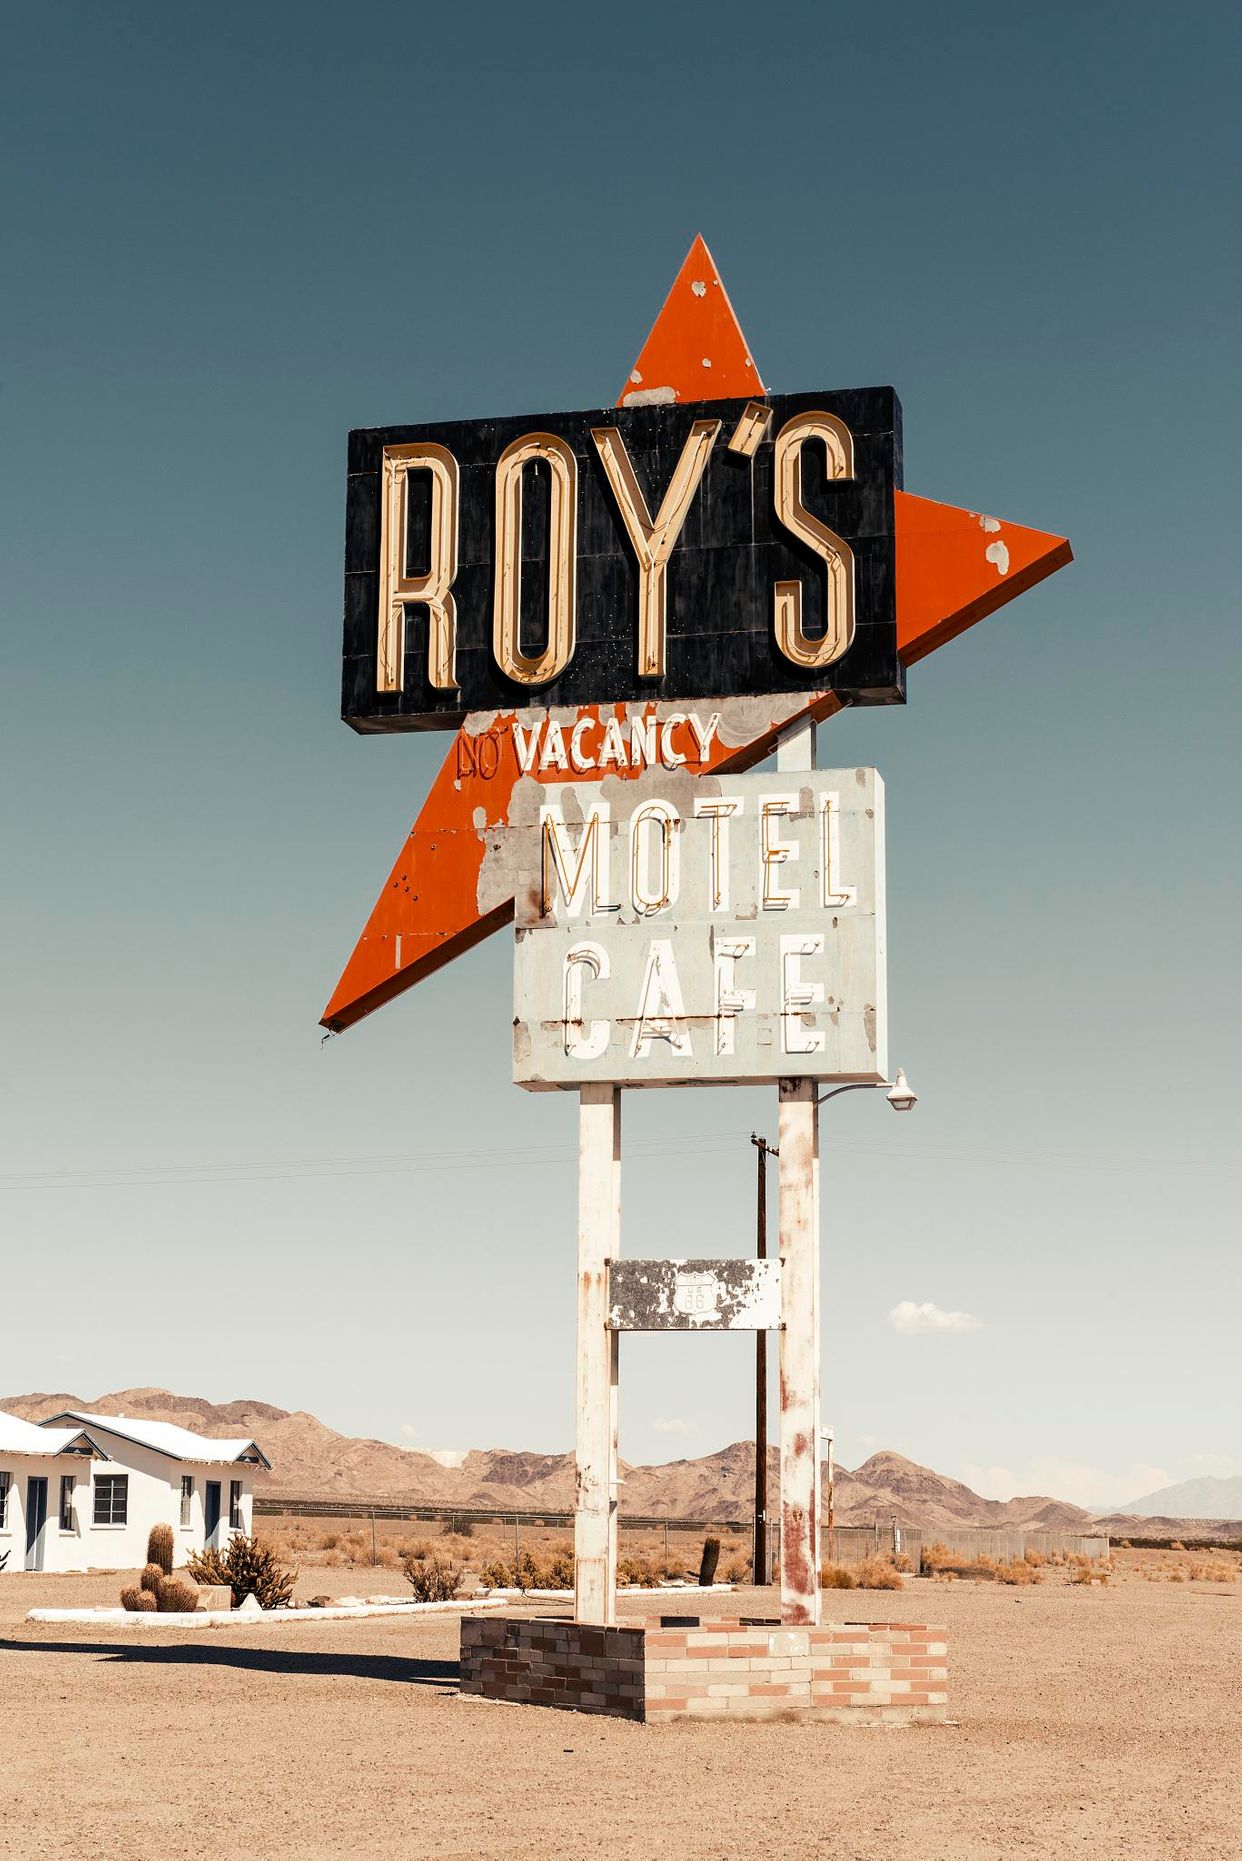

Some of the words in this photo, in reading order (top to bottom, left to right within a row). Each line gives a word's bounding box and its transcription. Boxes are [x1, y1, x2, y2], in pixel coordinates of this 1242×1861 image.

[376, 401, 856, 694] ROY'S
[457, 728, 499, 779] NO
[512, 712, 722, 773] VACANCY
[540, 791, 857, 917] MOTEL
[562, 934, 826, 1059] CAFE
[684, 1293, 705, 1310] 66
